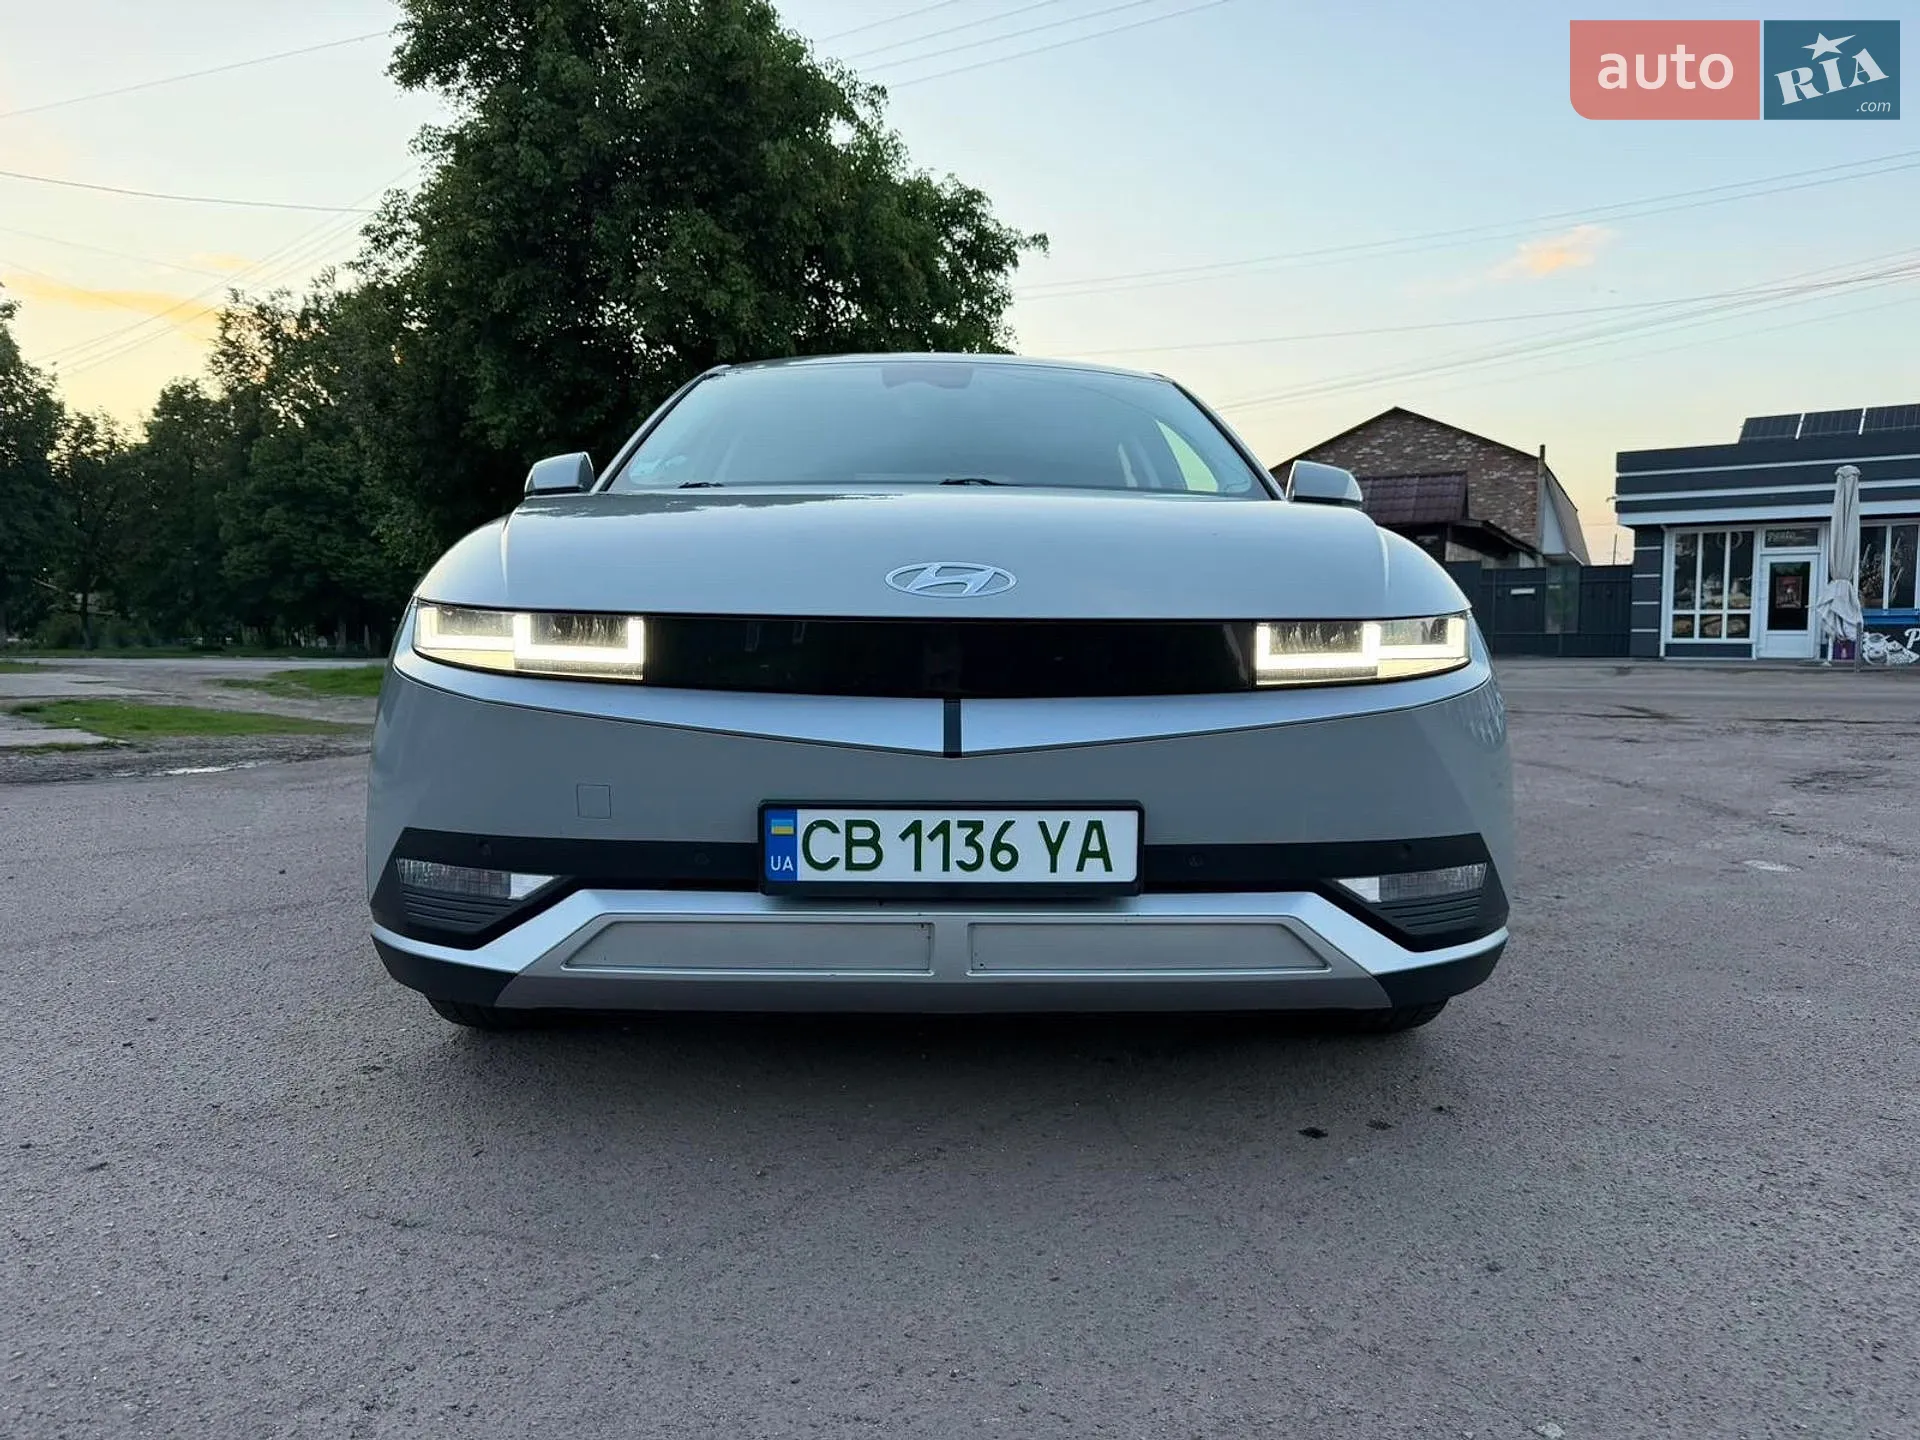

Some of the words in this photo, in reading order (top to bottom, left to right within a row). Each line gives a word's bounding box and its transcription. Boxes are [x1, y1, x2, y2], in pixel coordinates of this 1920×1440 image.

[770, 855, 794, 872] UA
[802, 819, 884, 872] CB
[898, 819, 1020, 872] 1136
[1037, 819, 1114, 874] YA
